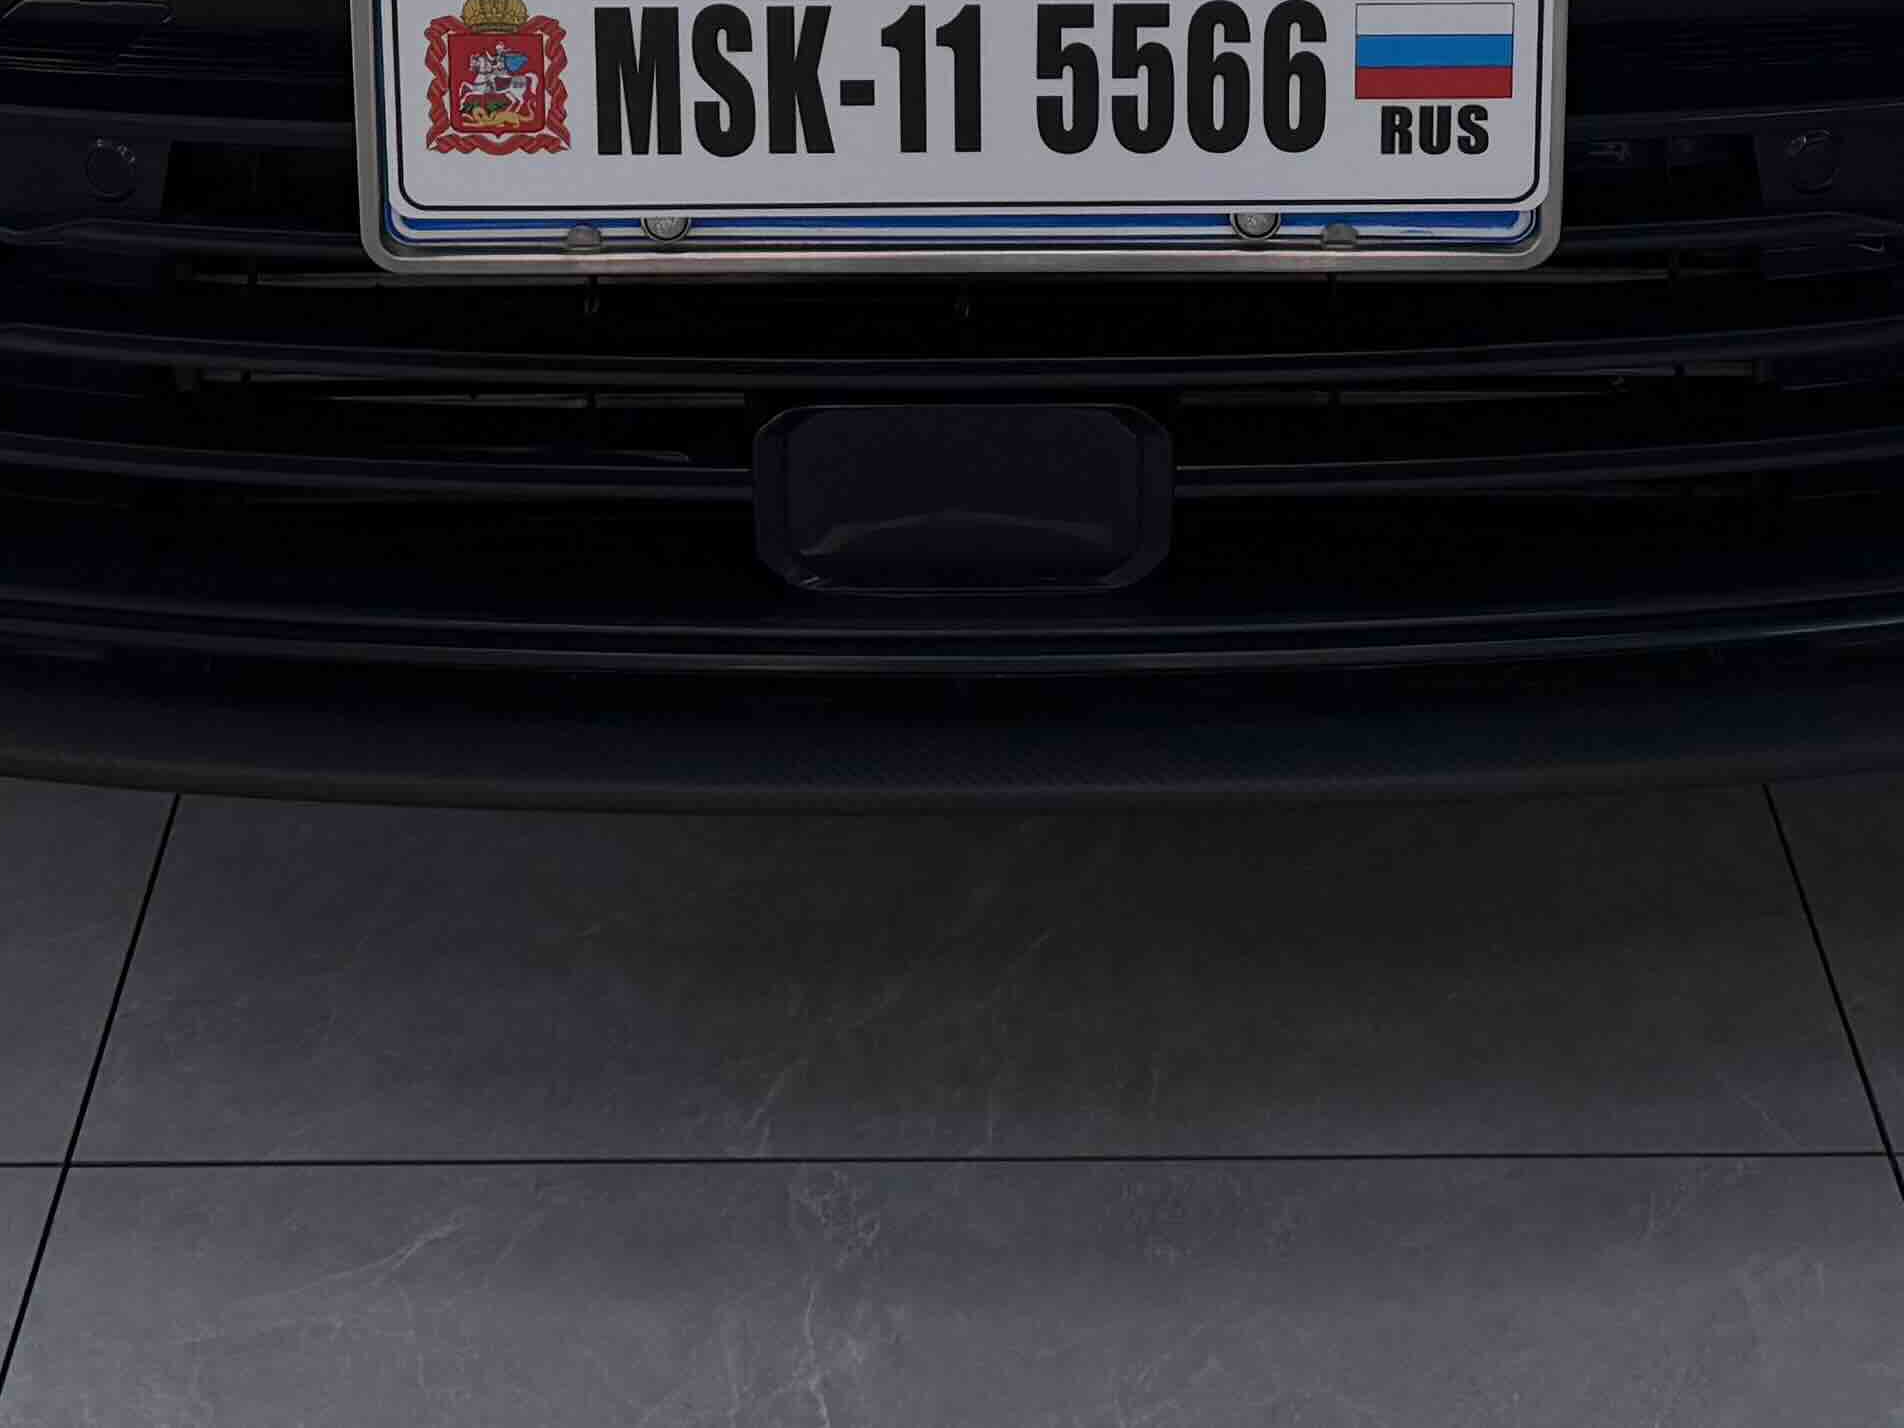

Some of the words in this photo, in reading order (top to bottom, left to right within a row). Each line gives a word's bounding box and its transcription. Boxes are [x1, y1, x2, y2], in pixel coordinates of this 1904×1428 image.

[594, 4, 982, 158] MSK-11
[1036, 0, 1327, 155] 5566
[1380, 105, 1490, 156] RUS
